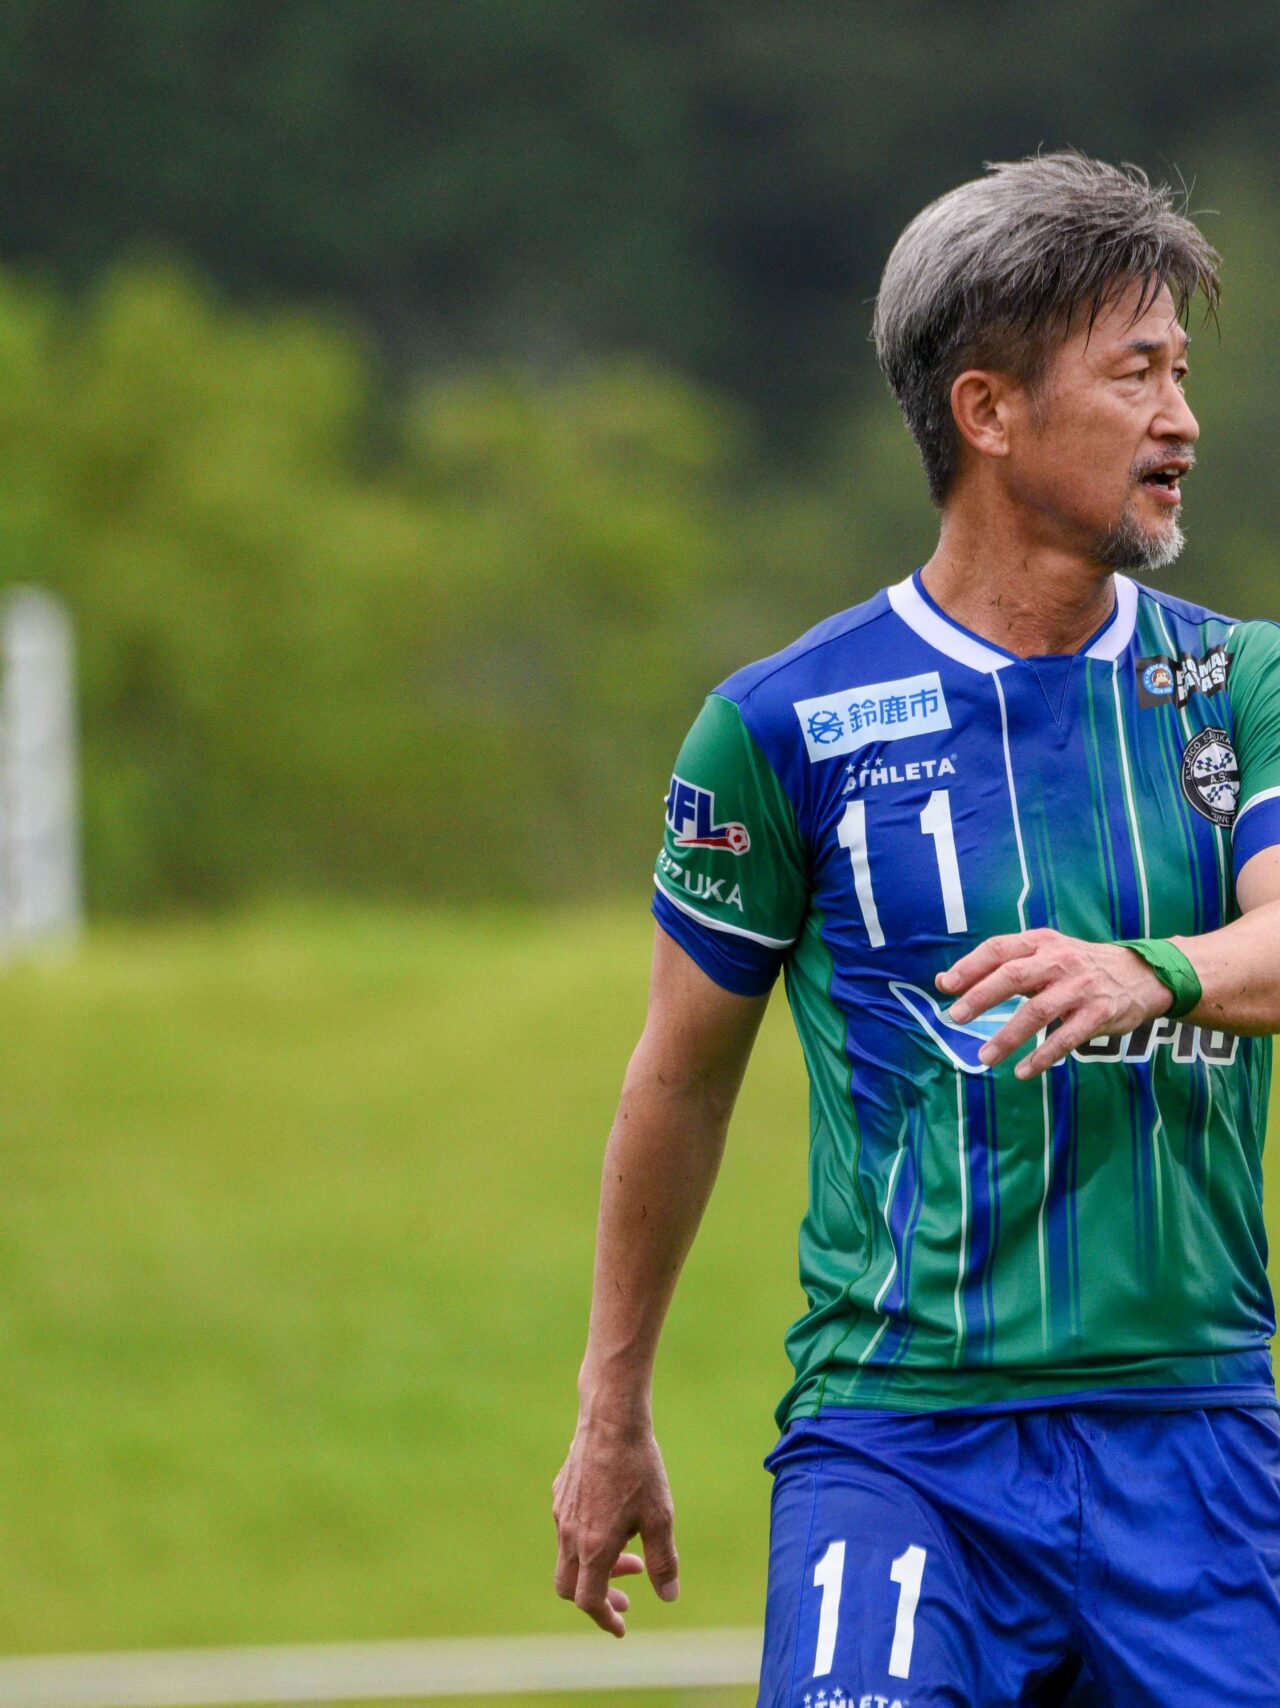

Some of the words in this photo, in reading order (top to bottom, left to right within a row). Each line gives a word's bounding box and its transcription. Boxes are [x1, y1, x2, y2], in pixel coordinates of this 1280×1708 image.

[847, 688, 939, 733] 鈴鹿市
[842, 757, 956, 795] ATHLETA
[837, 789, 968, 948] 11
[813, 1541, 926, 1679] 11
